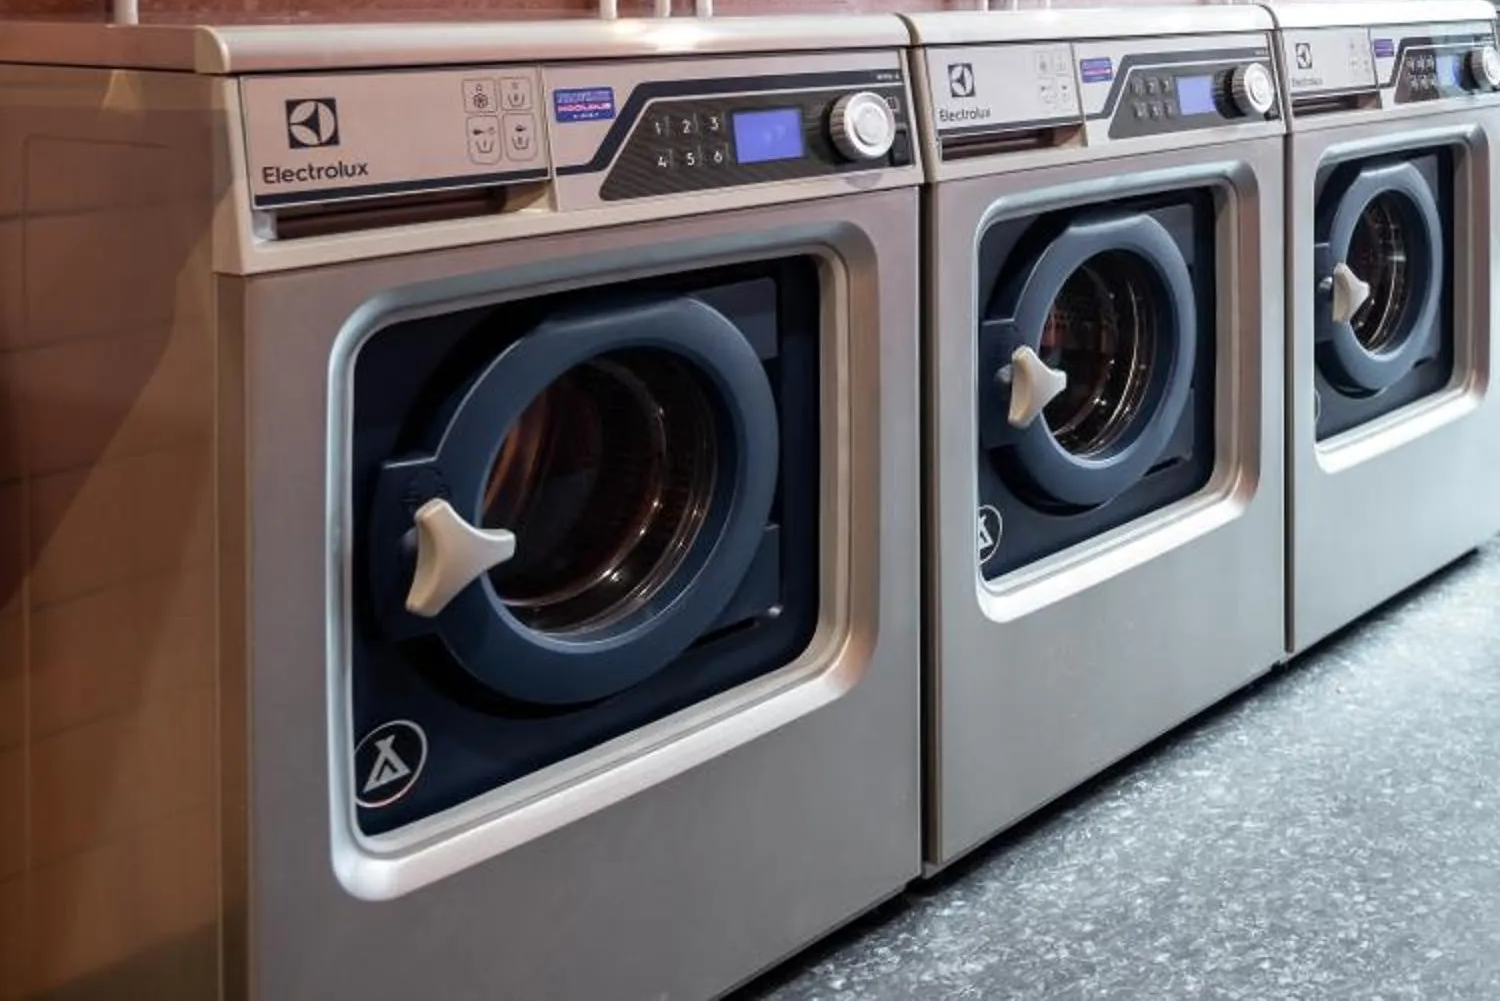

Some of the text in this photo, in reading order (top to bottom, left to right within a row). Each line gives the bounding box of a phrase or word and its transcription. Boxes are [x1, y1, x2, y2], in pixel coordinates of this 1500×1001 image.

[939, 107, 991, 122] Electrolux
[655, 116, 719, 135] 1 2 3
[658, 151, 723, 168] 4 5 6
[262, 160, 369, 184] Electrolux
